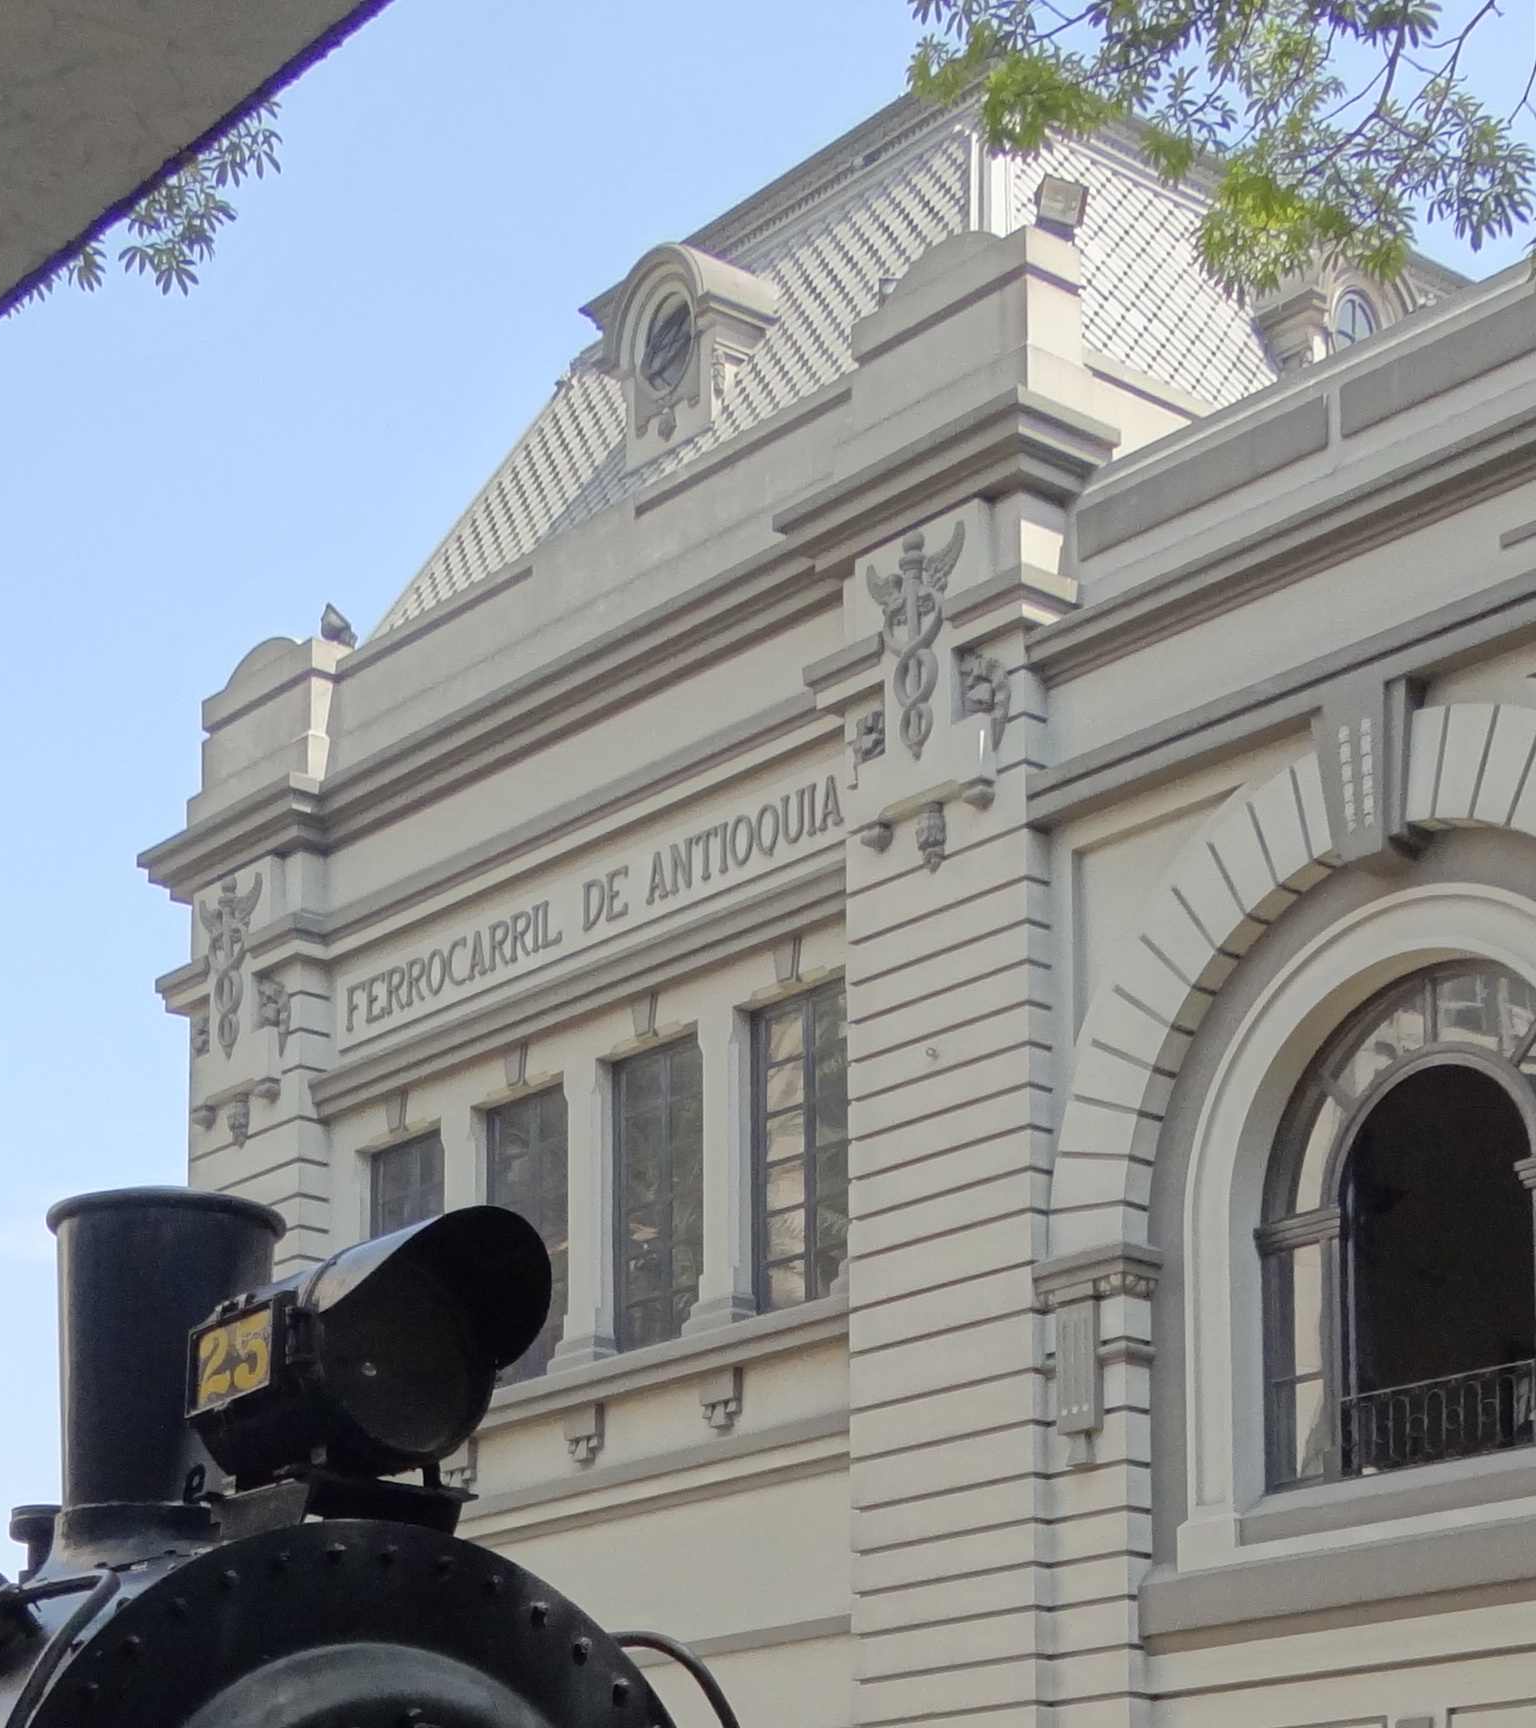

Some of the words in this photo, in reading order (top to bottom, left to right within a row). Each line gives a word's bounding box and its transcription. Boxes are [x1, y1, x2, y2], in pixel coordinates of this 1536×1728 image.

[346, 901, 562, 1033] FERROCARRIL
[582, 866, 629, 934] DE
[646, 775, 844, 905] ANTIOQUIA
[198, 1309, 269, 1405] 25
